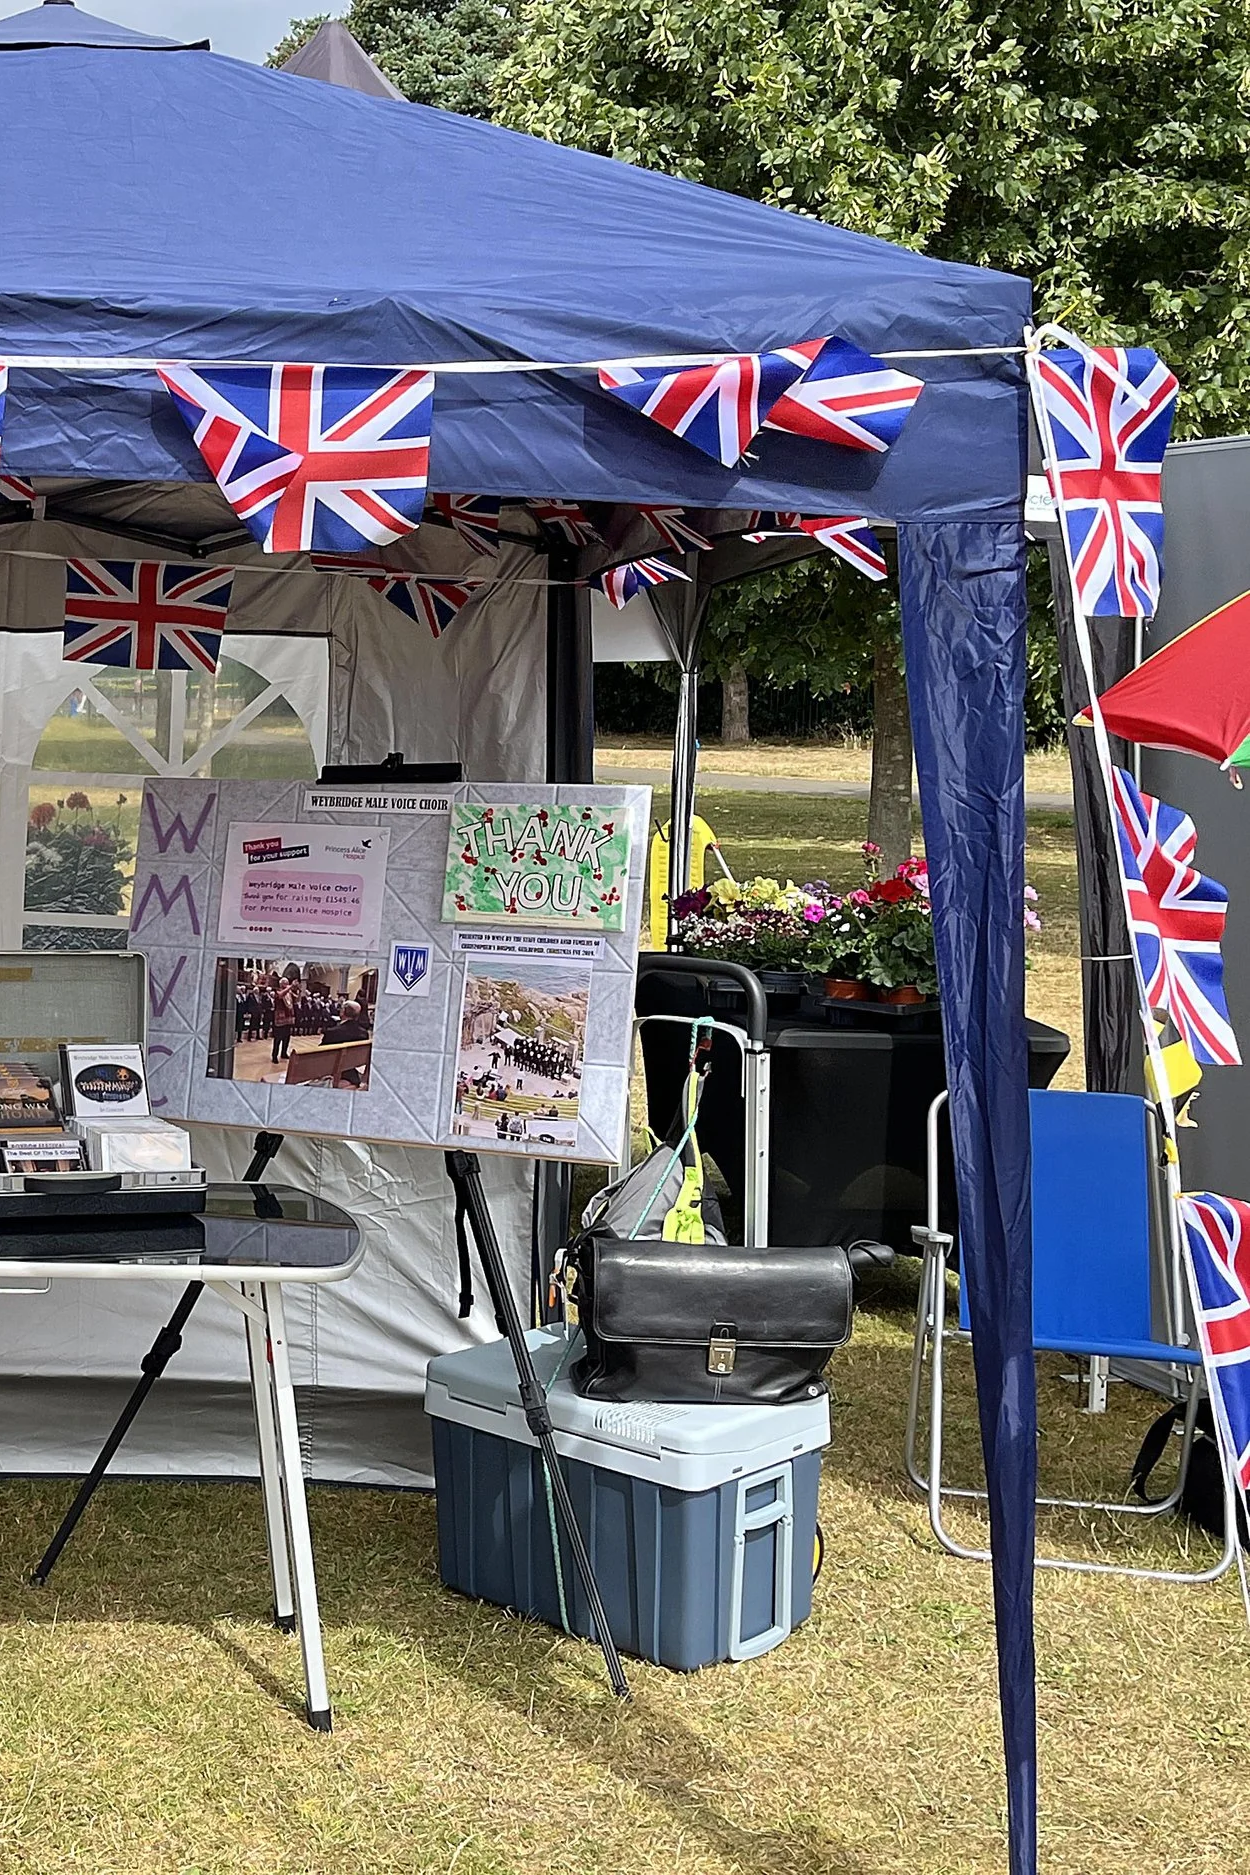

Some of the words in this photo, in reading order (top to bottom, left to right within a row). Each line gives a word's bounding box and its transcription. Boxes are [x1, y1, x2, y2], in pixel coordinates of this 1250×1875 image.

[311, 795, 363, 807] WEYBRIDGE
[364, 797, 388, 808] MALE
[391, 798, 417, 809] VOICE
[419, 799, 448, 810] CHOIR
[244, 843, 265, 851] Thank
[266, 841, 279, 850] you
[457, 815, 613, 871] THANK
[325, 845, 350, 854] Princess
[351, 846, 367, 854] Alice
[250, 854, 261, 862] for
[262, 853, 278, 862] your
[279, 848, 307, 859] support
[493, 871, 583, 911] YOU
[292, 895, 322, 903] raising
[321, 908, 352, 916] Hospice
[0, 1111, 43, 1119] HOME
